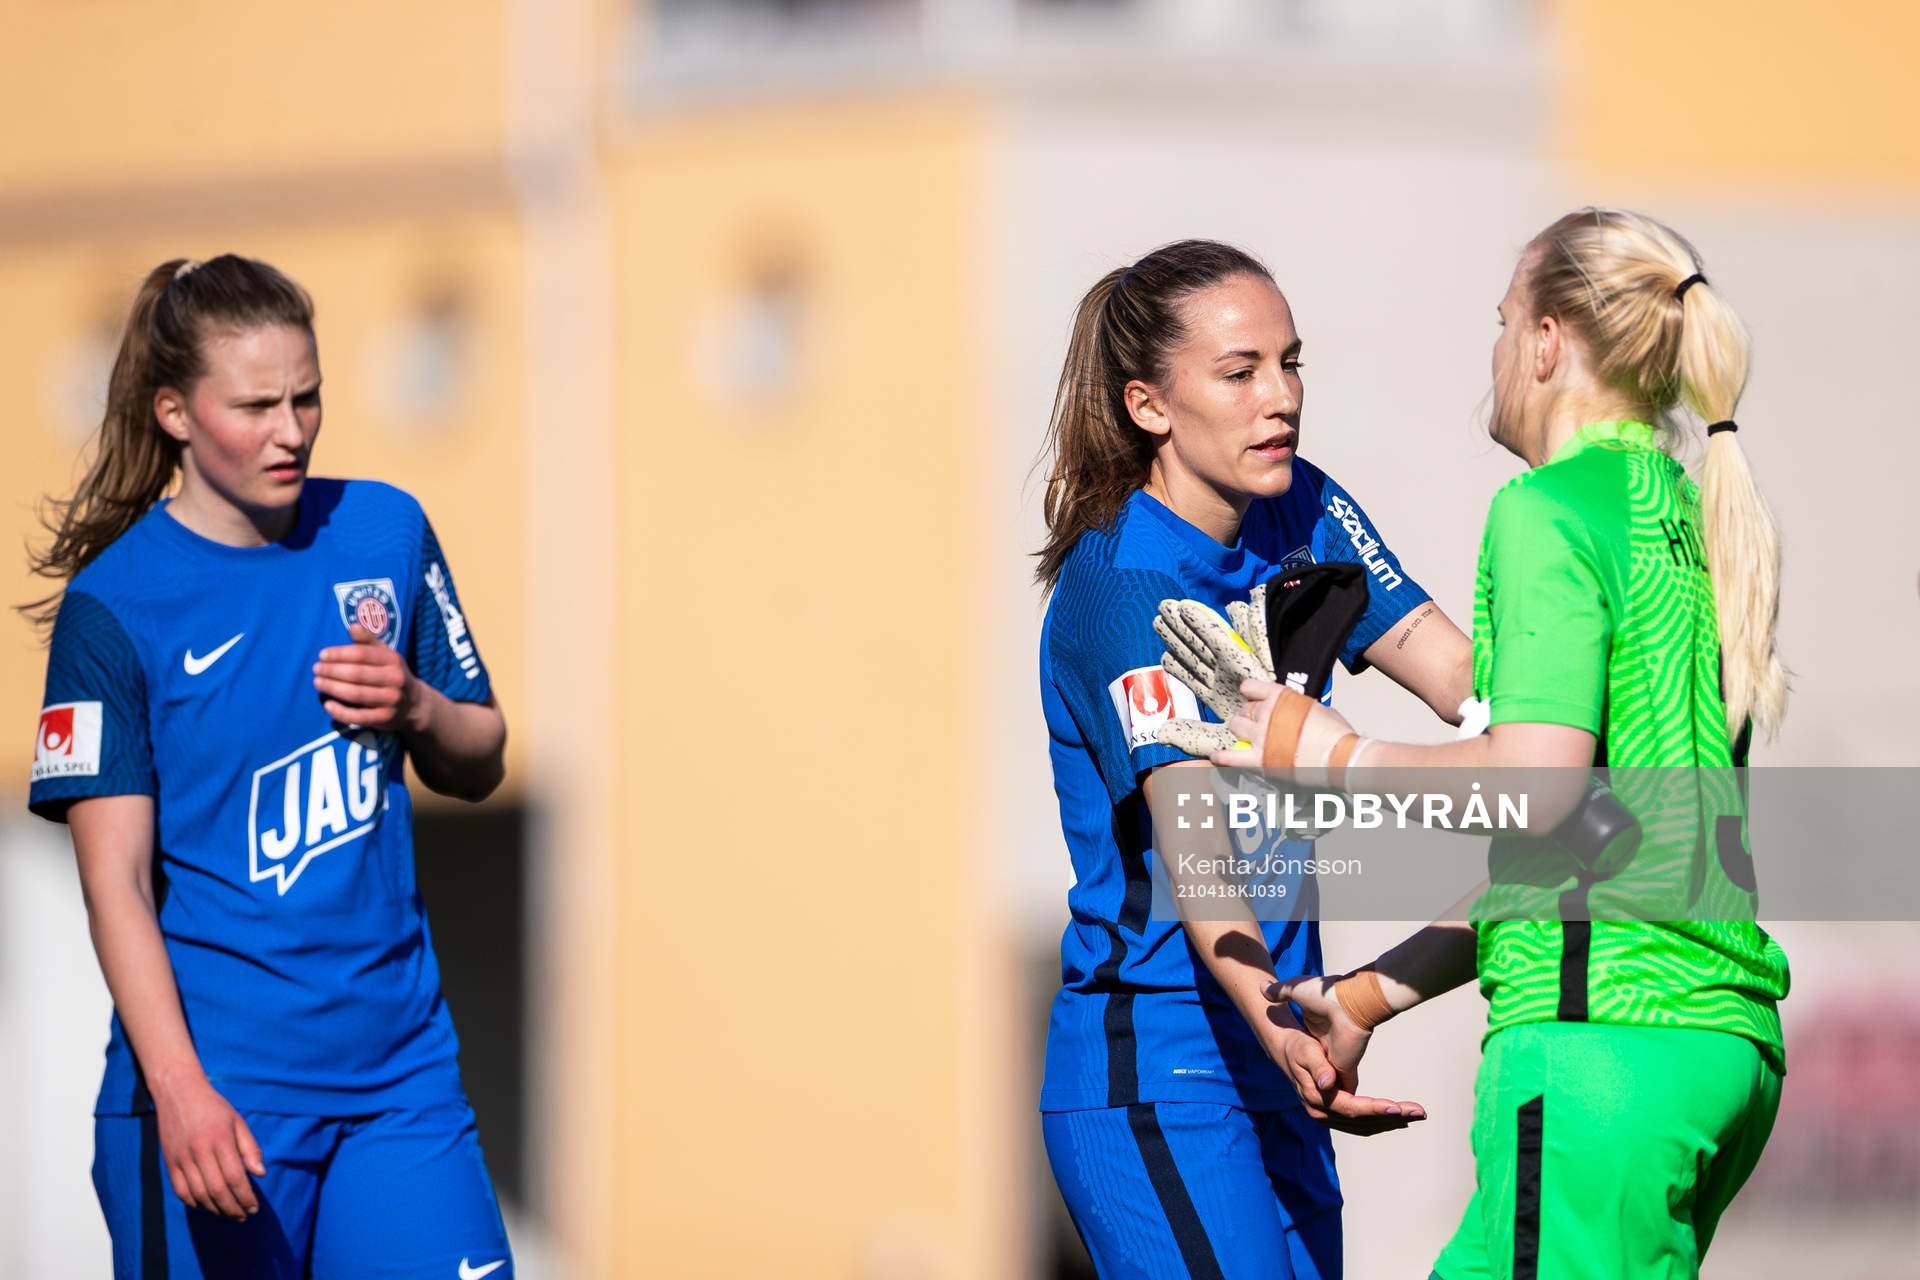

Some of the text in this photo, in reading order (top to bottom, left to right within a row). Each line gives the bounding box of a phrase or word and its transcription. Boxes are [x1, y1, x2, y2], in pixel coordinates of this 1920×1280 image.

[1327, 495, 1403, 592] stadium
[1396, 628, 1412, 649] count
[1411, 618, 1422, 628] on
[260, 731, 381, 860] JAG
